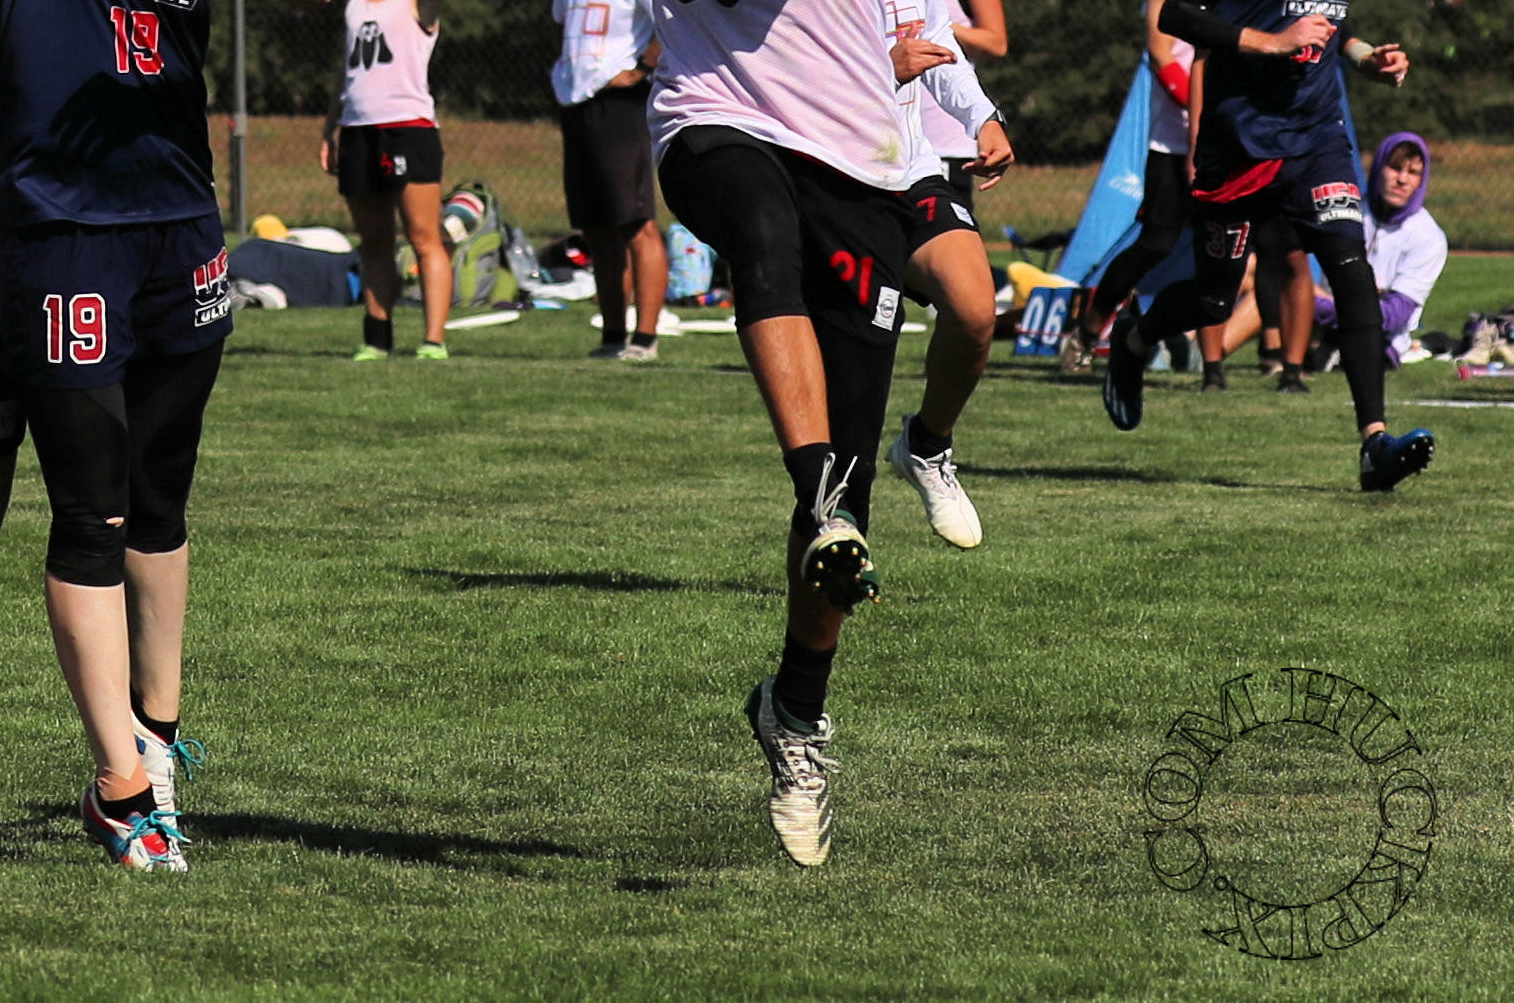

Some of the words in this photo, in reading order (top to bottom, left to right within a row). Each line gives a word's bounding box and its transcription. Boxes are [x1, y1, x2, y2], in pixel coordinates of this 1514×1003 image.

[1288, 1, 1348, 18] ULTIMATE
[110, 6, 165, 75] 19
[916, 196, 938, 222] 7
[1311, 181, 1362, 212] USA
[42, 293, 107, 365] 19
[1019, 296, 1067, 346] 06
